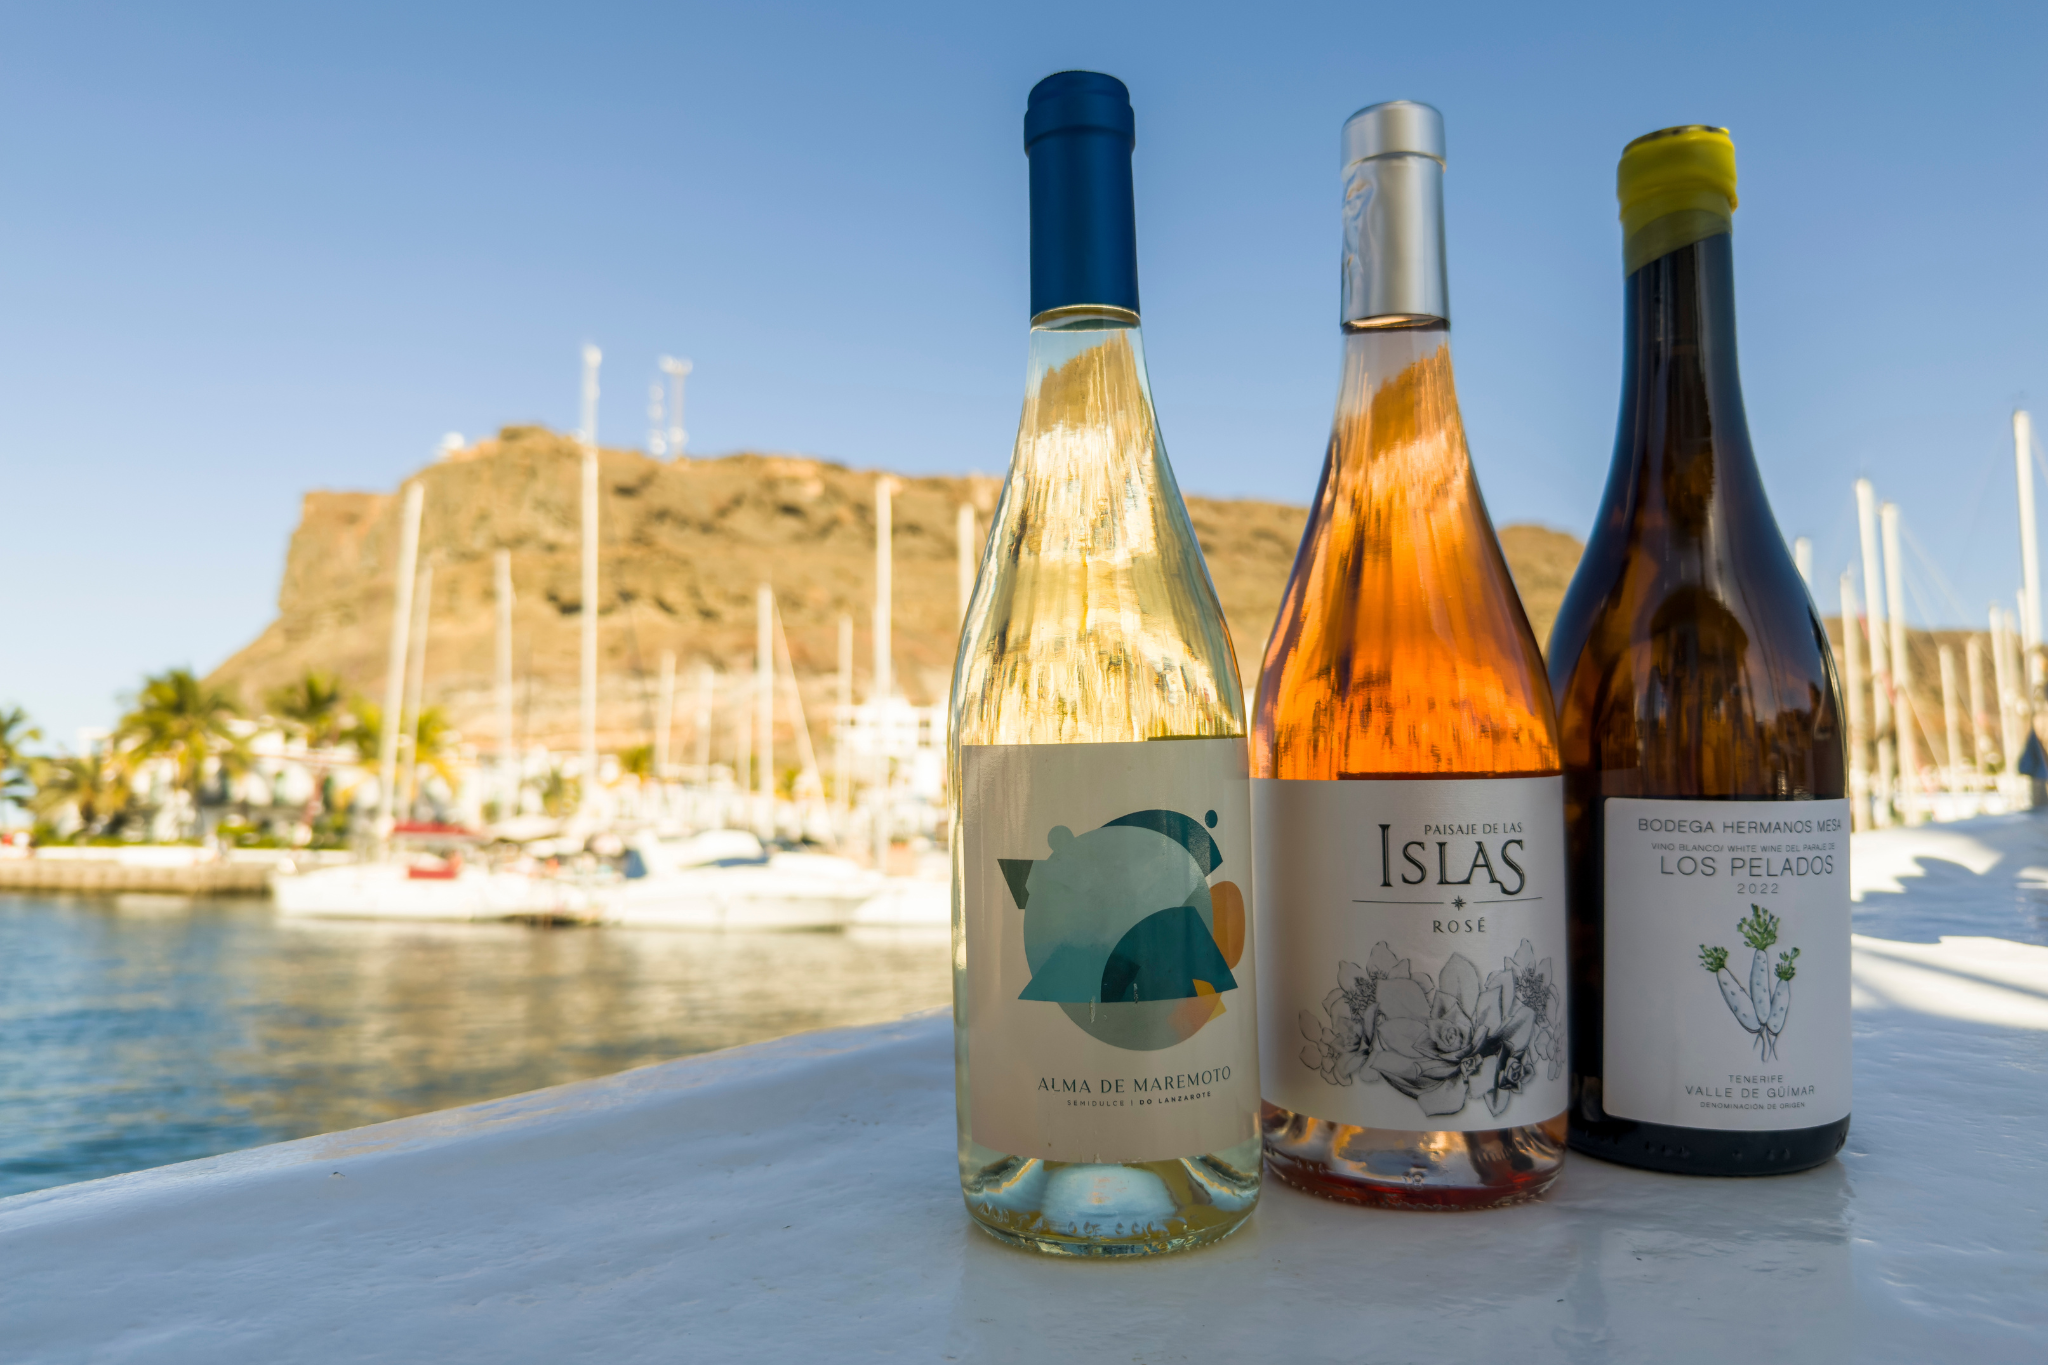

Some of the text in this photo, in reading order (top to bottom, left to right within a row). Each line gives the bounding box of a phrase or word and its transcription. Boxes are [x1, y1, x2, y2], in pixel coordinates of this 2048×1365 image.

[1424, 822, 1522, 836] PAISAJE DE LAS
[1638, 818, 1842, 834] BODEGA HERMANOS MESA
[1651, 842, 1675, 851] VINO
[1727, 844, 1756, 853] WHITE
[1760, 844, 1782, 853] WINE
[1786, 844, 1800, 852] DEL
[1803, 843, 1827, 851] PARAJE
[1828, 842, 1835, 850] DE
[1661, 855, 1834, 877] LOS PELADOS
[1737, 883, 1779, 894] 2022
[1432, 917, 1486, 933] ROSÉ
[1038, 1065, 1231, 1093] ALMA DE MAREMOTO
[1728, 1074, 1783, 1084] TENERIFE
[1139, 1098, 1153, 1106] DO
[1158, 1091, 1212, 1104] LANZAROTE
[1685, 1085, 1732, 1098] VALLE
[1741, 1088, 1759, 1098] DE
[1779, 1101, 1806, 1109] ORIGEN
